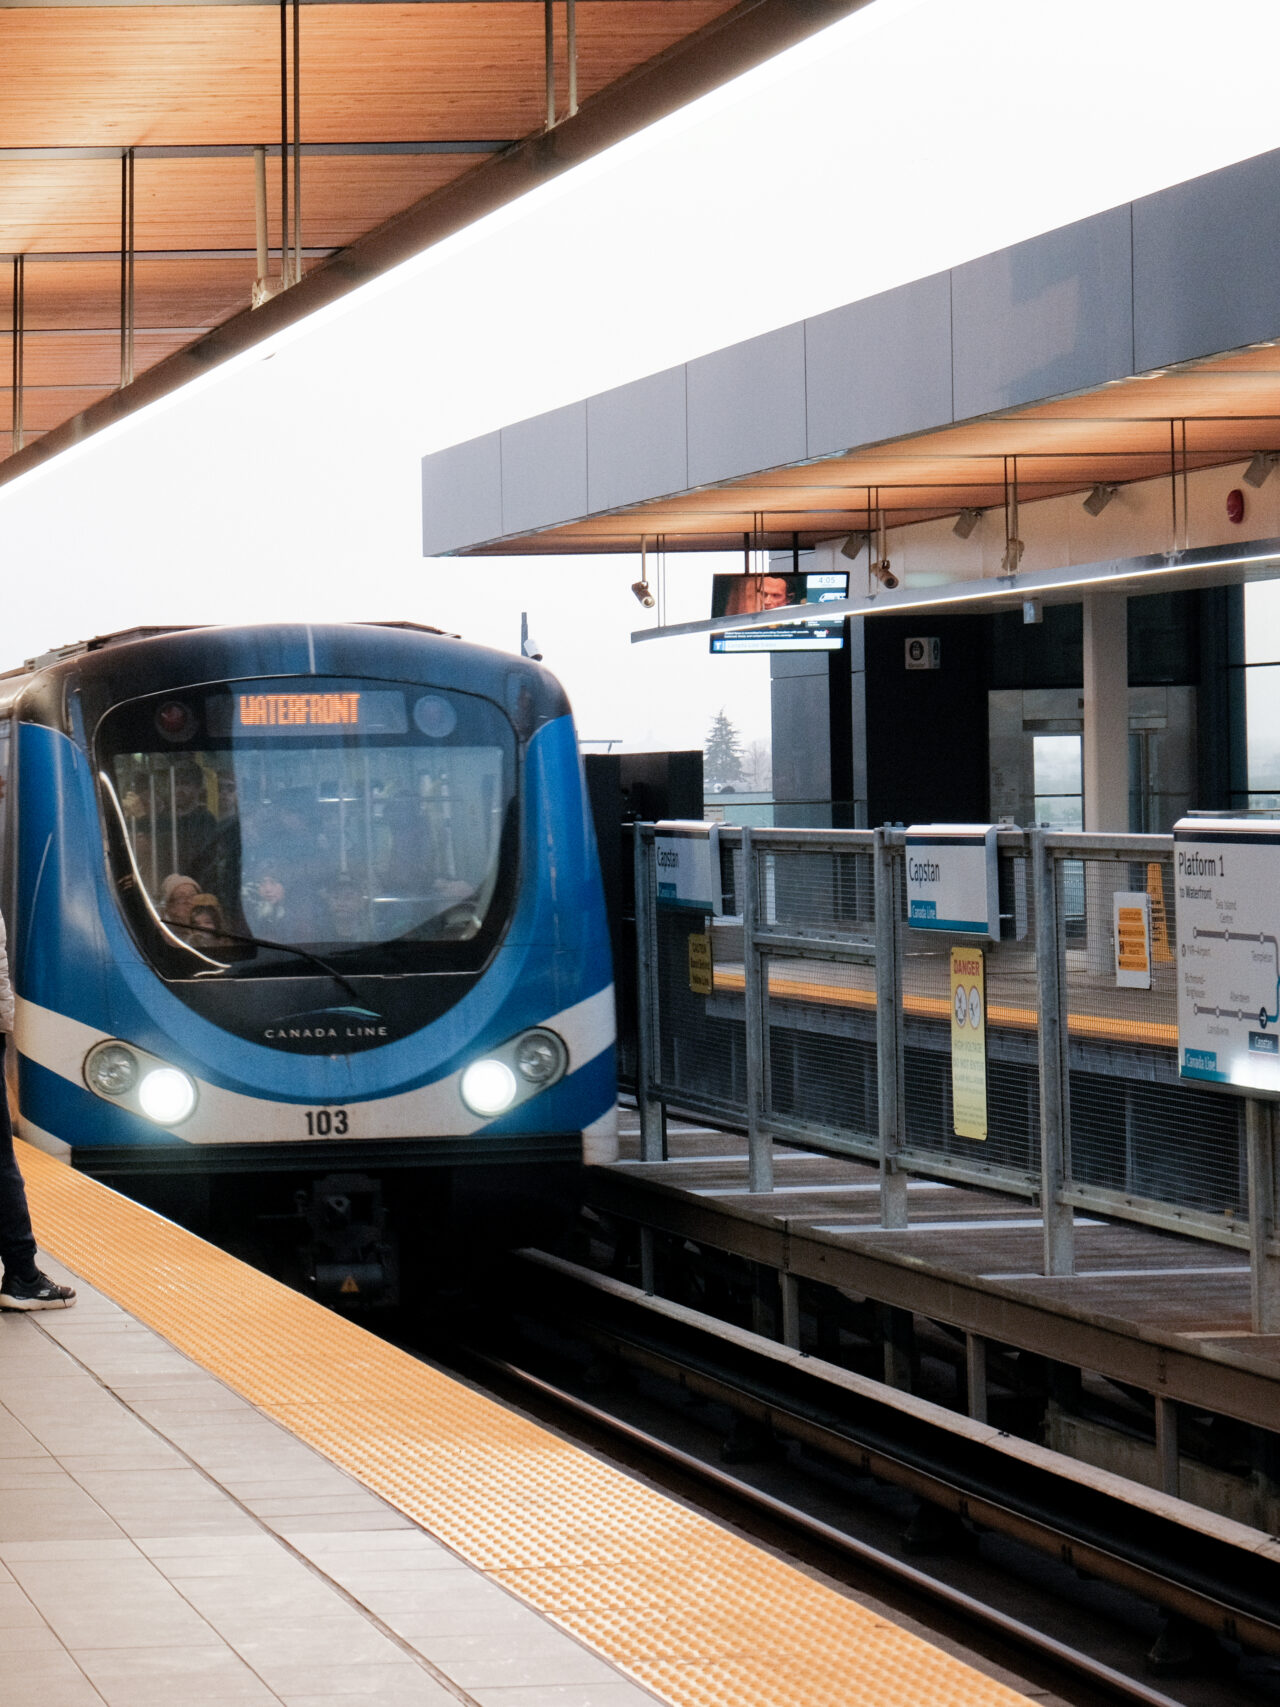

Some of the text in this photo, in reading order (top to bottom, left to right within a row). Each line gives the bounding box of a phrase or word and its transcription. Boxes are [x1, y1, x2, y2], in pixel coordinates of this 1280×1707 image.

[239, 693, 361, 725] WATERFRONT
[656, 846, 680, 872] Capstan
[1179, 851, 1224, 877] Platform 1
[908, 857, 940, 888] Capstan
[1186, 886, 1212, 899] Waterfront
[953, 959, 980, 976] DANGER
[264, 1026, 388, 1039] CANADA LINE
[1186, 1053, 1216, 1071] Canada Line
[305, 1110, 349, 1136] 103
